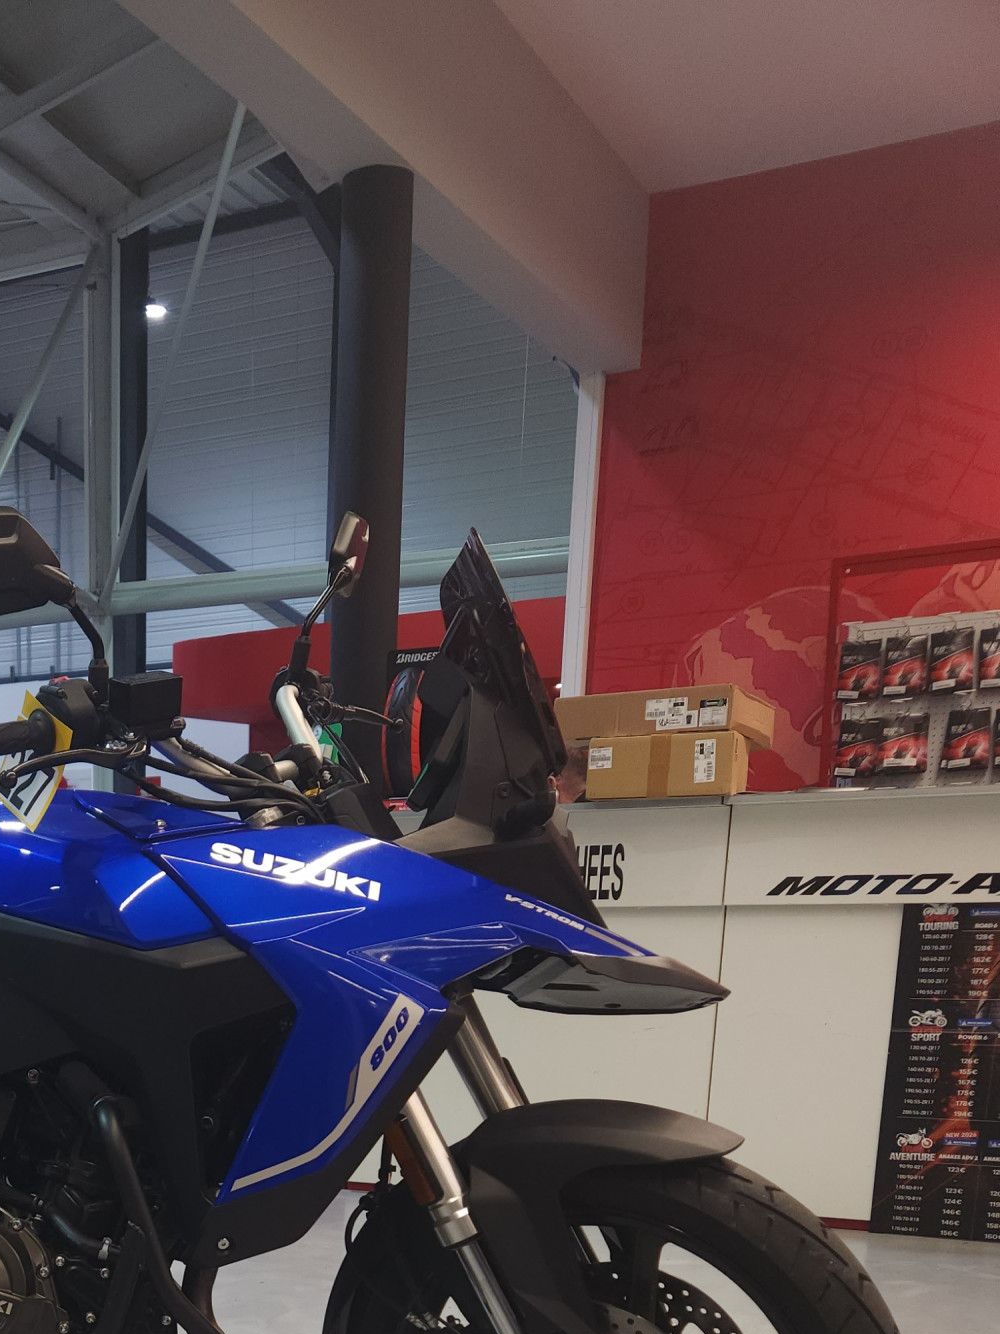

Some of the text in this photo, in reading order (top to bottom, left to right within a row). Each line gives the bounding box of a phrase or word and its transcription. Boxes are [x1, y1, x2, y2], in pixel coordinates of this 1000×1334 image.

[209, 842, 382, 902] SUZUKI
[505, 893, 585, 931] V-STROM
[918, 921, 959, 931] TOURING
[370, 1006, 410, 1072] 800
[910, 1033, 941, 1041] SPORT
[889, 1152, 936, 1161] AVENTURE
